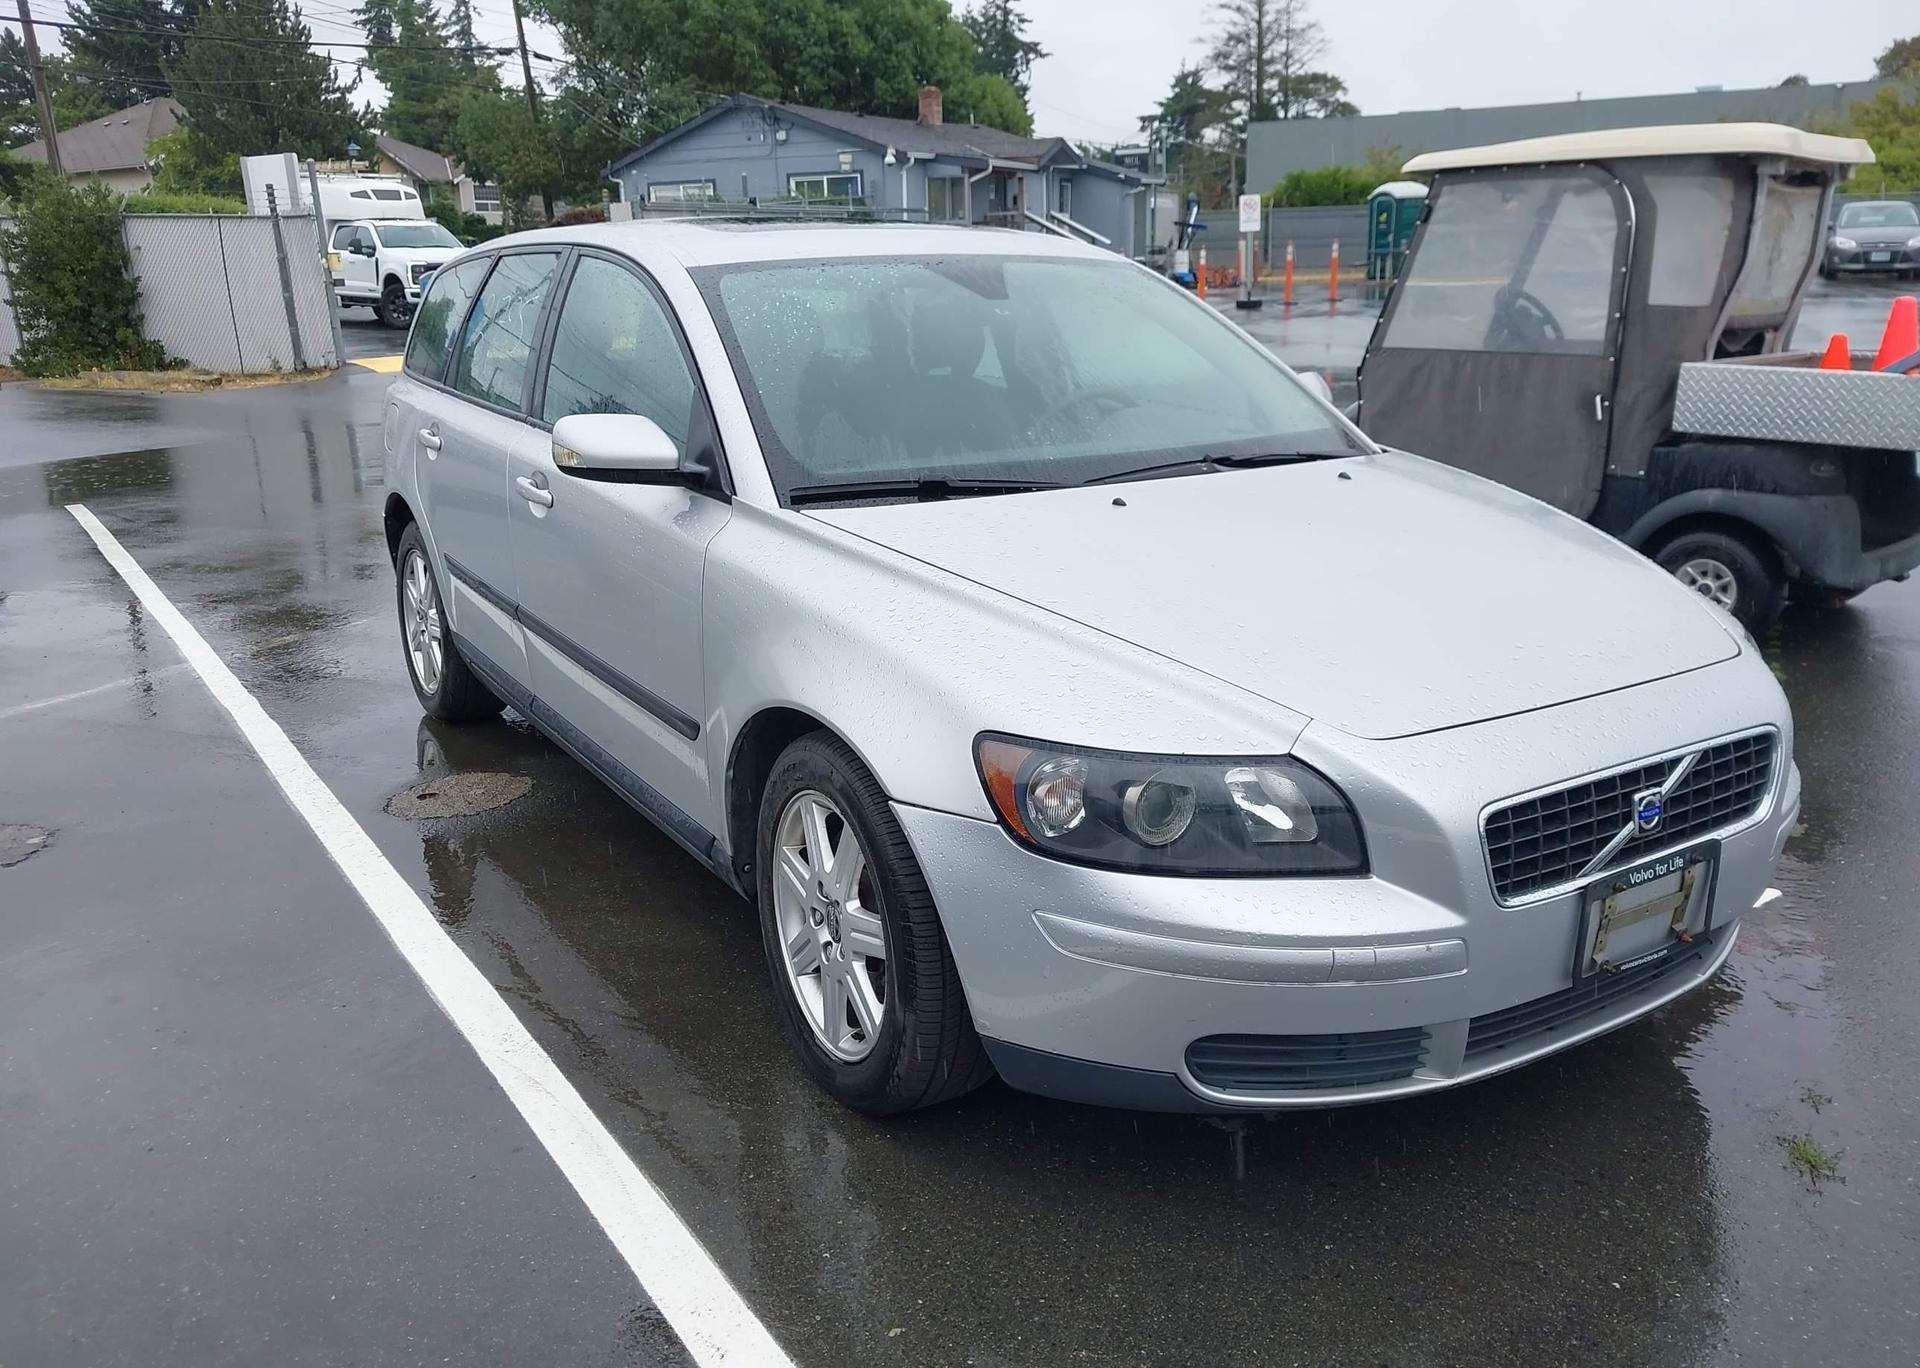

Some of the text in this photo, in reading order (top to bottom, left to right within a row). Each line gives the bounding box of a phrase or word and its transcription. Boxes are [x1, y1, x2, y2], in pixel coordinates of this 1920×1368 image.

[1629, 856, 1684, 885] Volvo for Life
